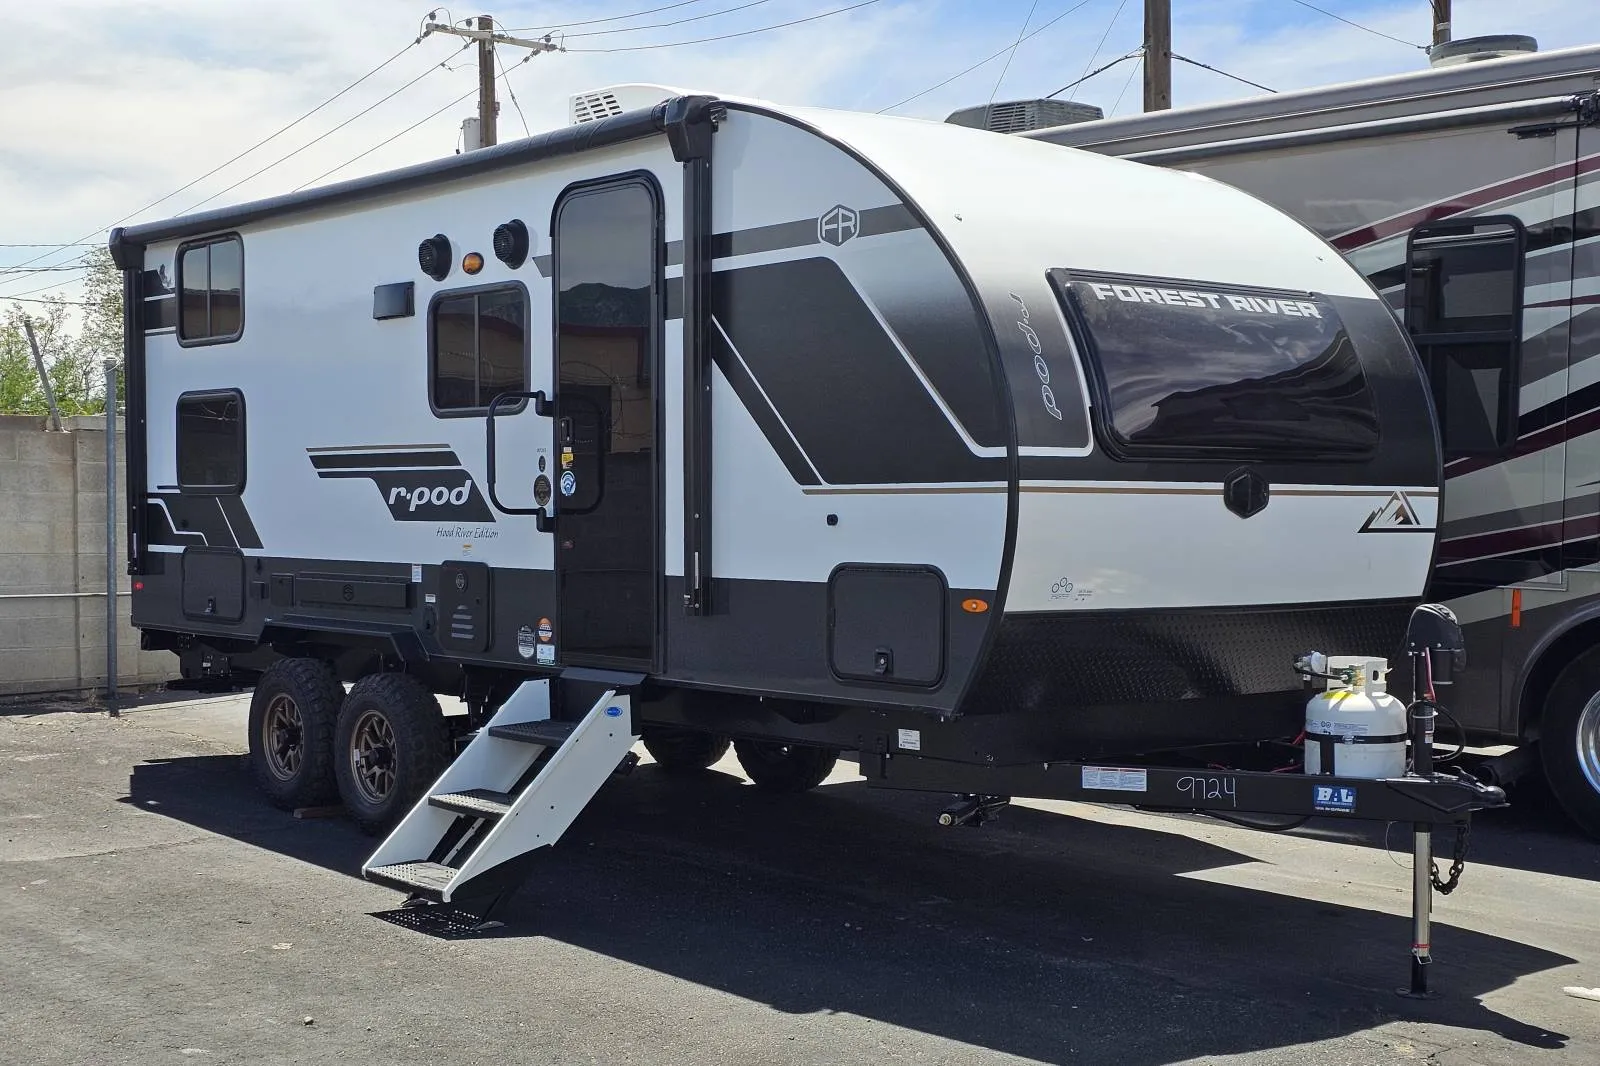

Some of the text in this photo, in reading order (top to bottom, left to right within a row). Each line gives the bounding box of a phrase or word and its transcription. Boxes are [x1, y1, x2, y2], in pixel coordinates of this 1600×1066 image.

[1088, 283, 1323, 319] FOREST RIVER
[436, 524, 499, 539] Hood River Edition
[1176, 776, 1237, 808] 9724
[1317, 787, 1354, 803] BAL
